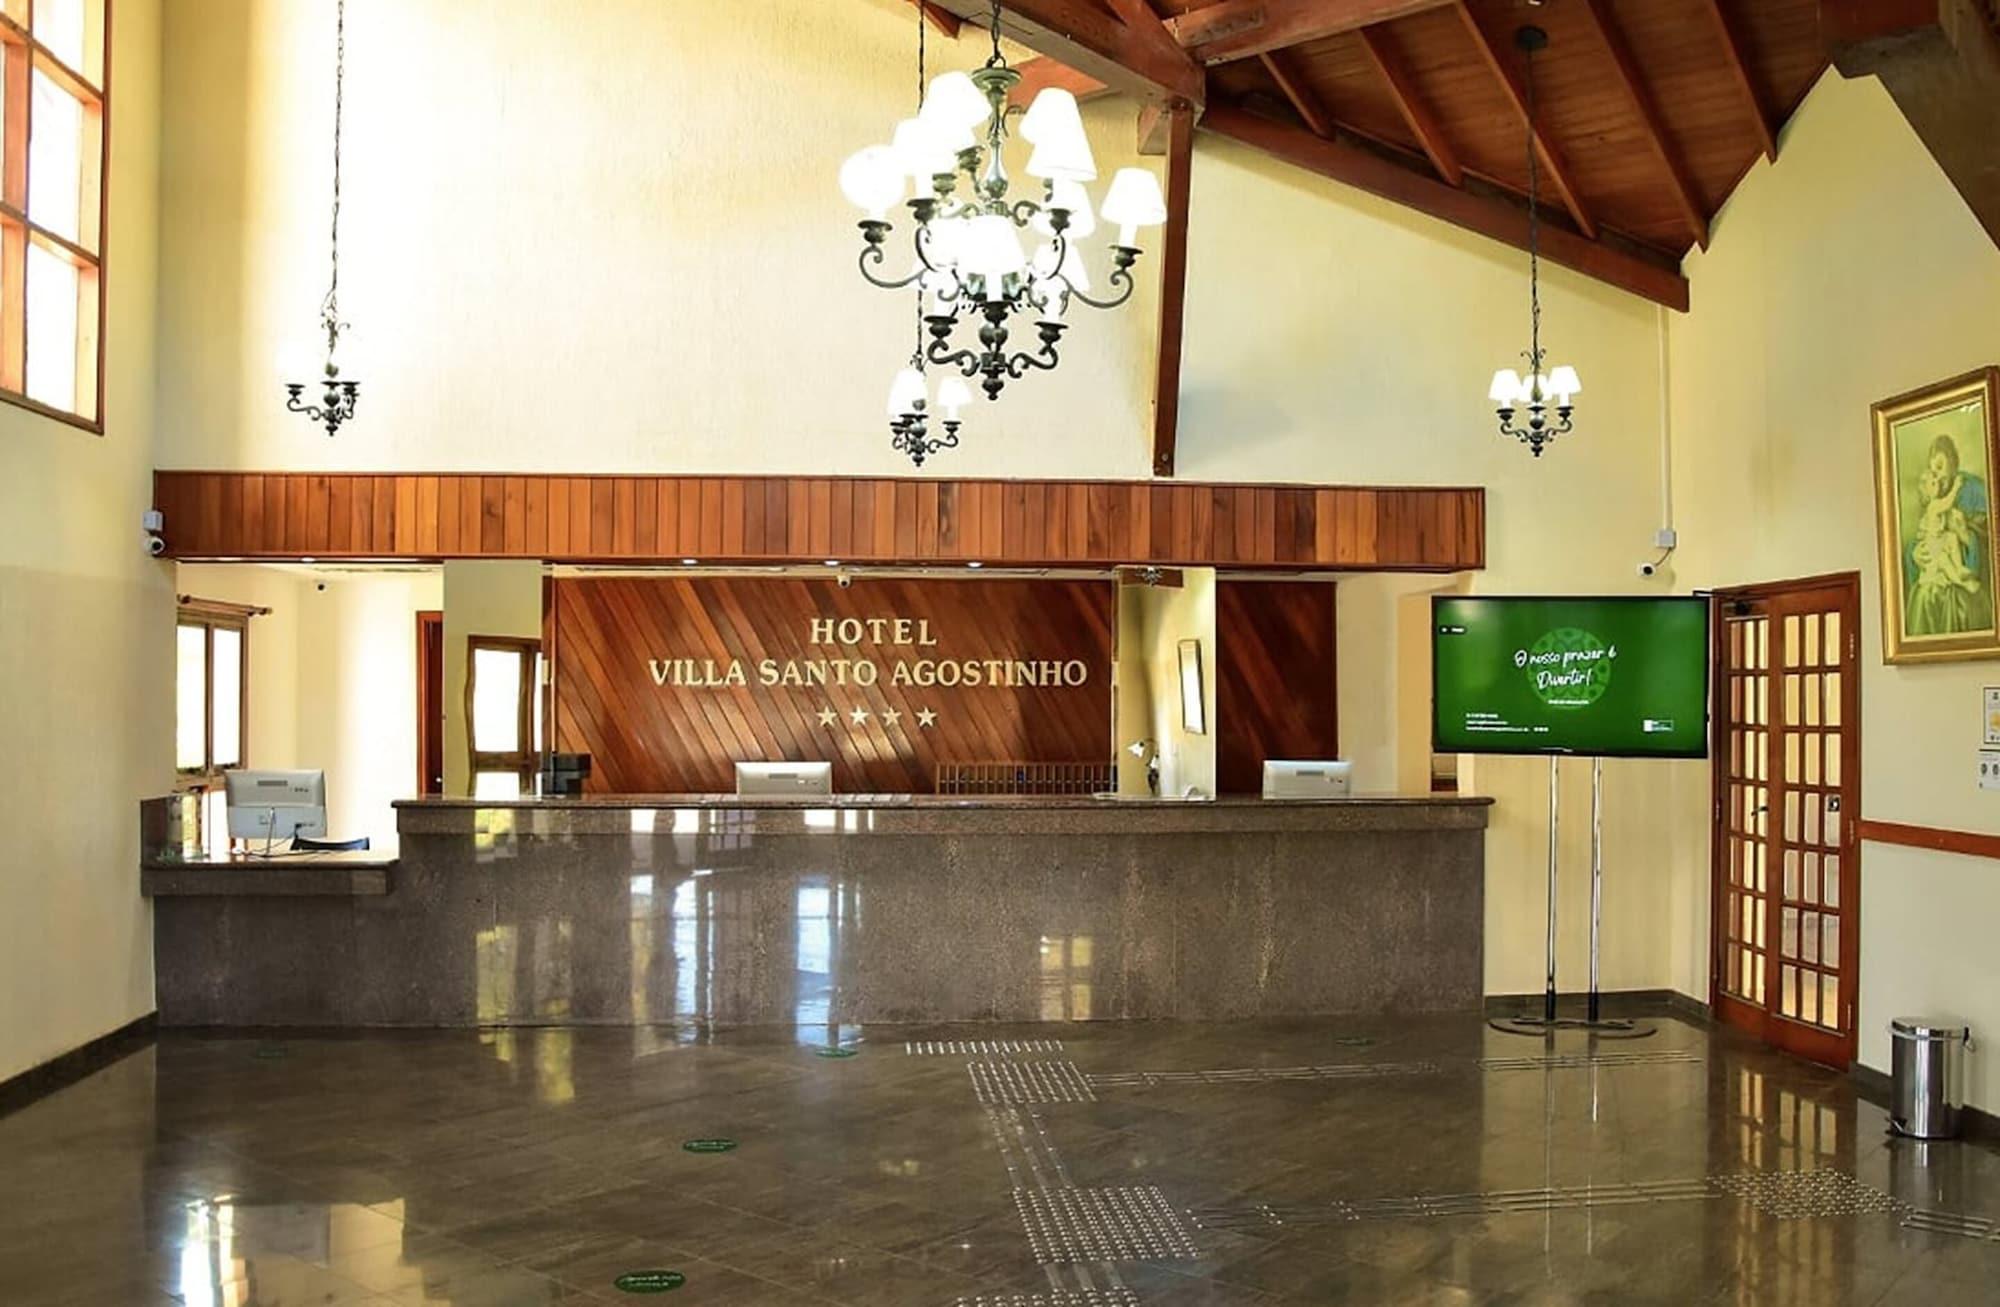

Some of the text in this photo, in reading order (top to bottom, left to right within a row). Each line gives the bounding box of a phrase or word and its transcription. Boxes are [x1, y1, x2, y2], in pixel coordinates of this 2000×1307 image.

[810, 618, 937, 646] HOTEL
[1529, 651, 1561, 665] nosso
[648, 659, 1088, 687] VILLA SANTO AGOSTINHO
